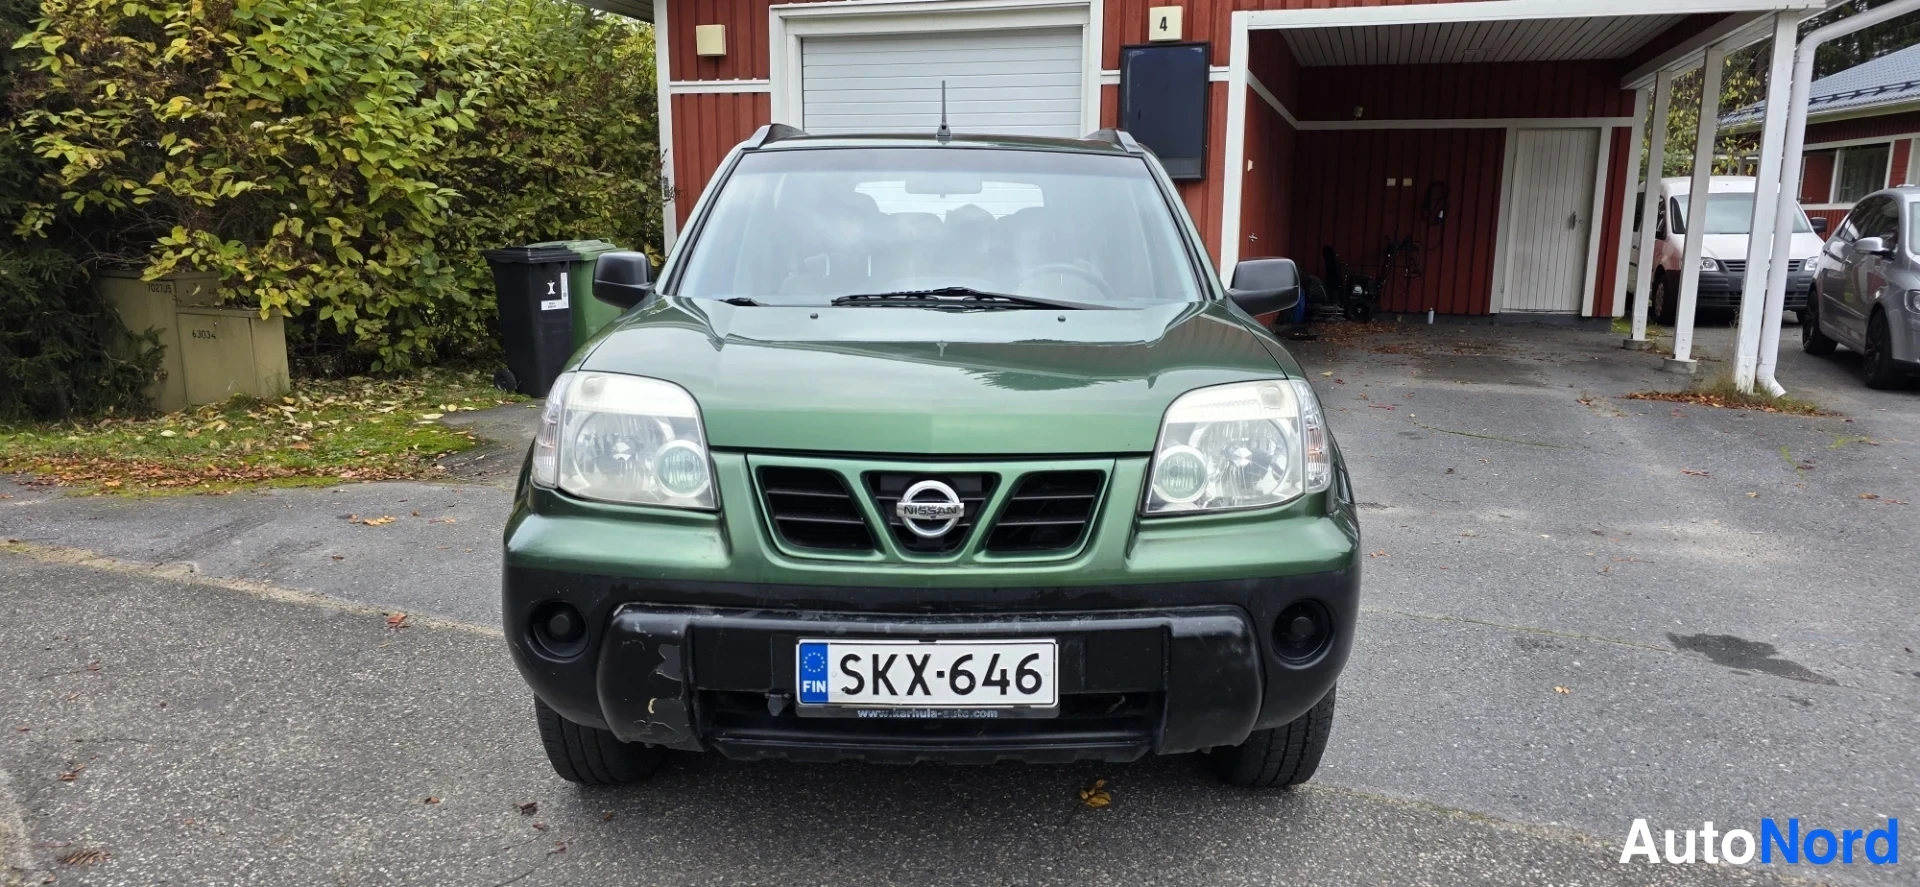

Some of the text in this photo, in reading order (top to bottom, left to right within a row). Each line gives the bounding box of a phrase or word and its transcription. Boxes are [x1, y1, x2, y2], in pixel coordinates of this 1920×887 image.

[1159, 16, 1168, 31] 4
[904, 506, 957, 516] NISSAN
[840, 653, 1042, 695] SKX-646
[803, 680, 827, 693] FIN
[857, 708, 998, 718] www.karhula-auto.com
